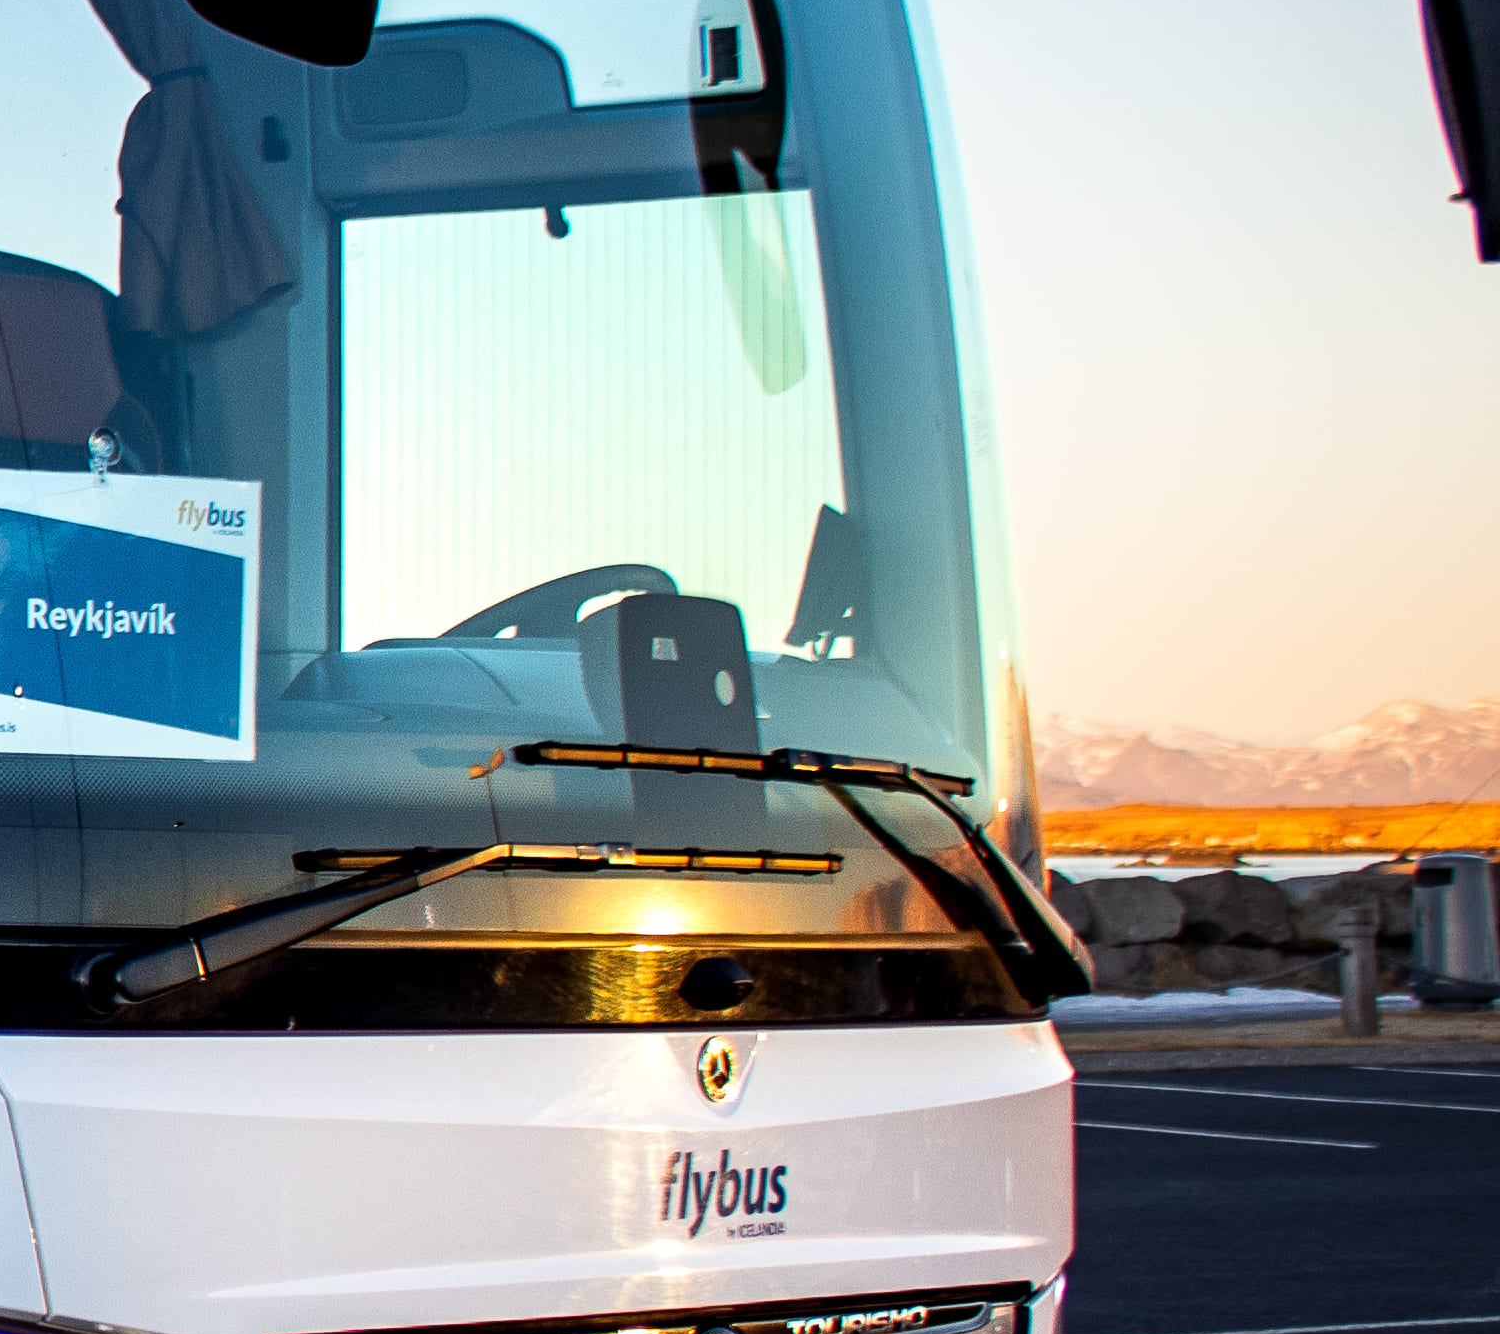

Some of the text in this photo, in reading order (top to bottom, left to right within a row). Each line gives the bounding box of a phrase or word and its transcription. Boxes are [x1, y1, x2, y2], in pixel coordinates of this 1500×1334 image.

[178, 499, 245, 532] flybus
[26, 597, 176, 639] Reykjavík
[660, 1149, 788, 1240] flybus
